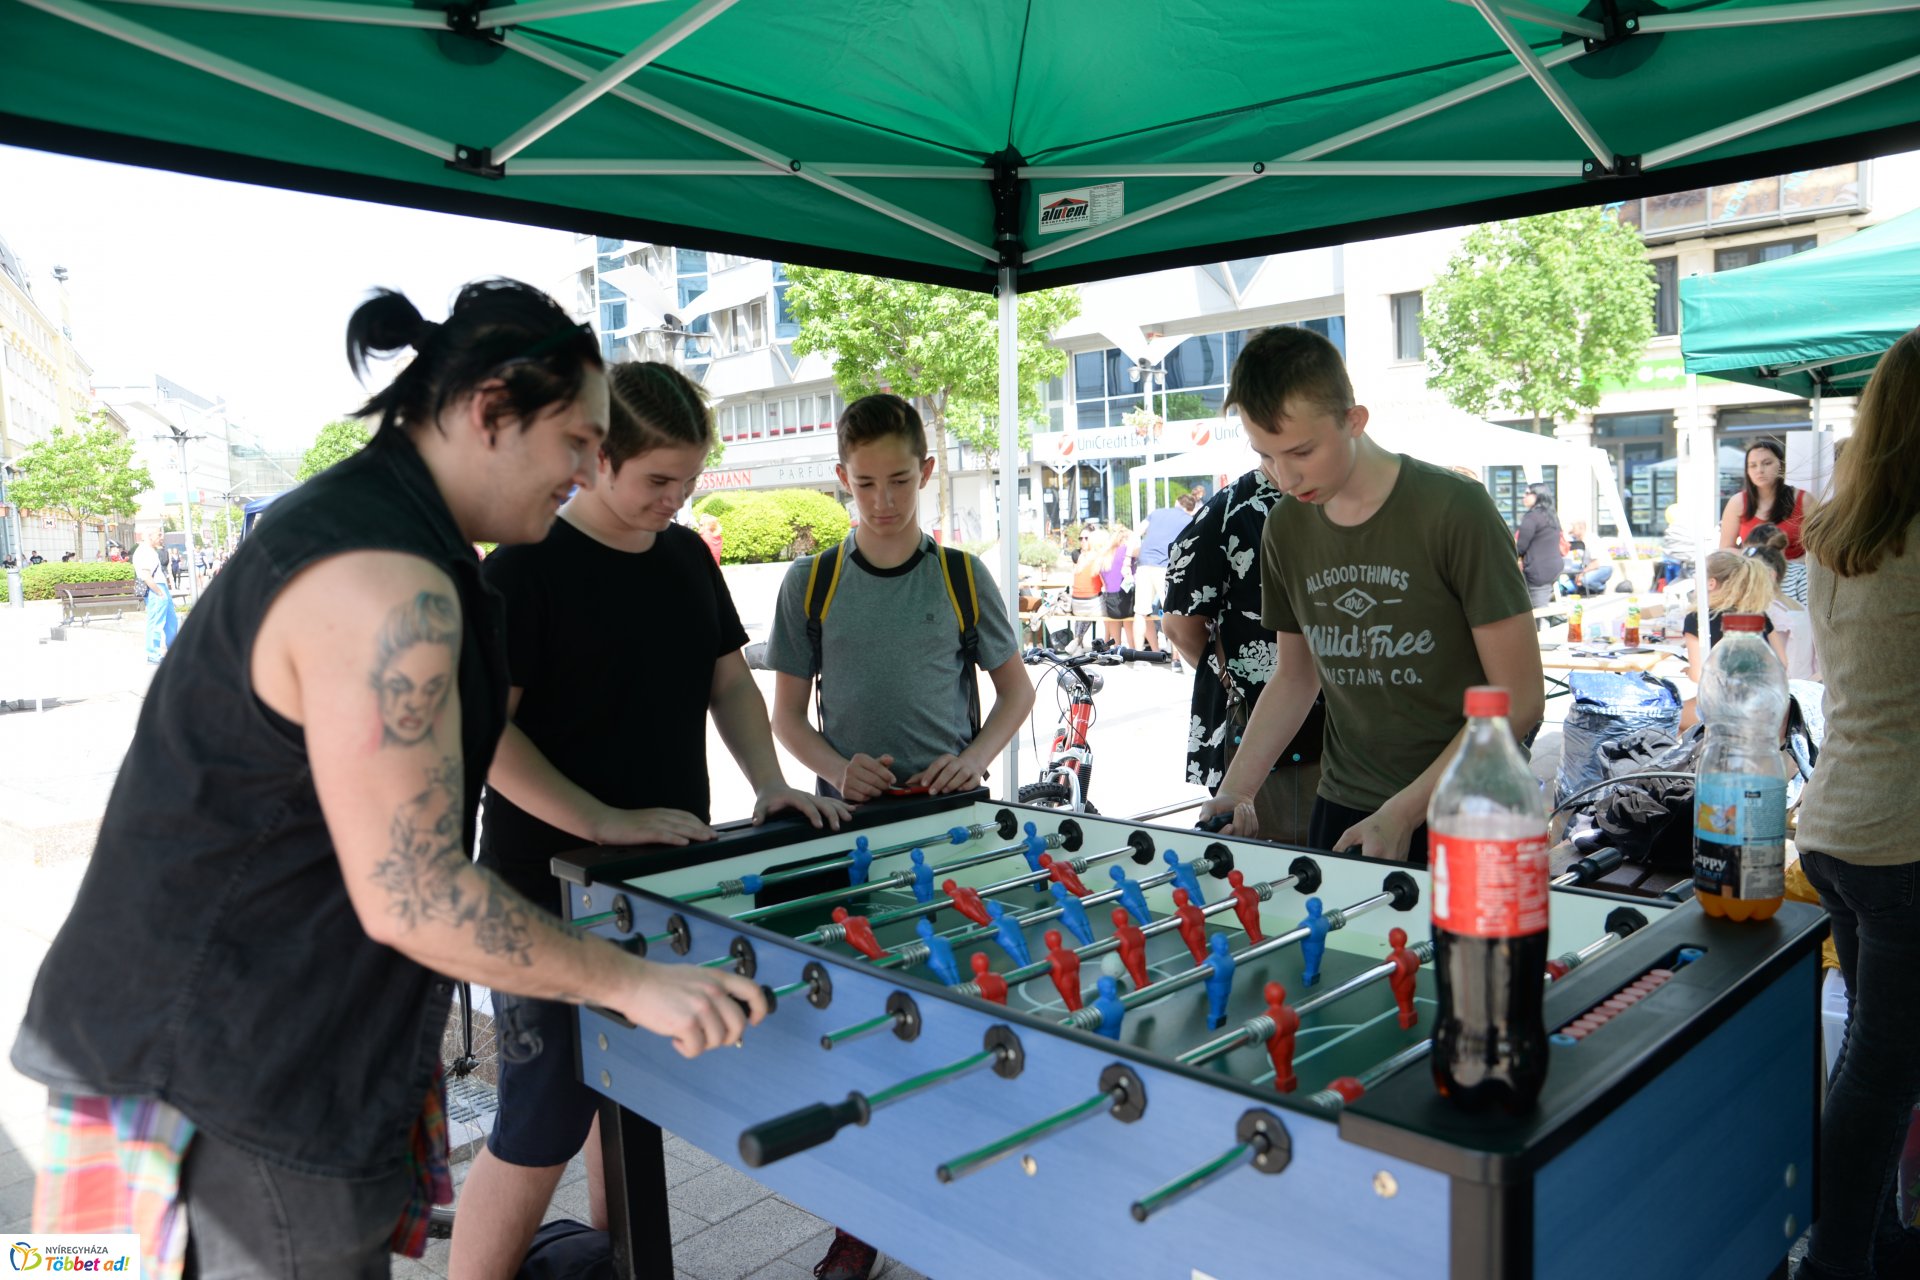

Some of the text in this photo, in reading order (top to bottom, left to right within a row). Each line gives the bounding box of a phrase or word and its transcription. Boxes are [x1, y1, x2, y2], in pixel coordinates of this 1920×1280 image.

[1077, 434, 1127, 451] UniCredit
[695, 468, 752, 490] OSSMANN
[1306, 564, 1410, 595] ALL GOOD THINGS
[1344, 597, 1365, 611] are
[1303, 624, 1363, 658] Wild
[1367, 624, 1436, 659] Free
[1390, 667, 1423, 686] CO.
